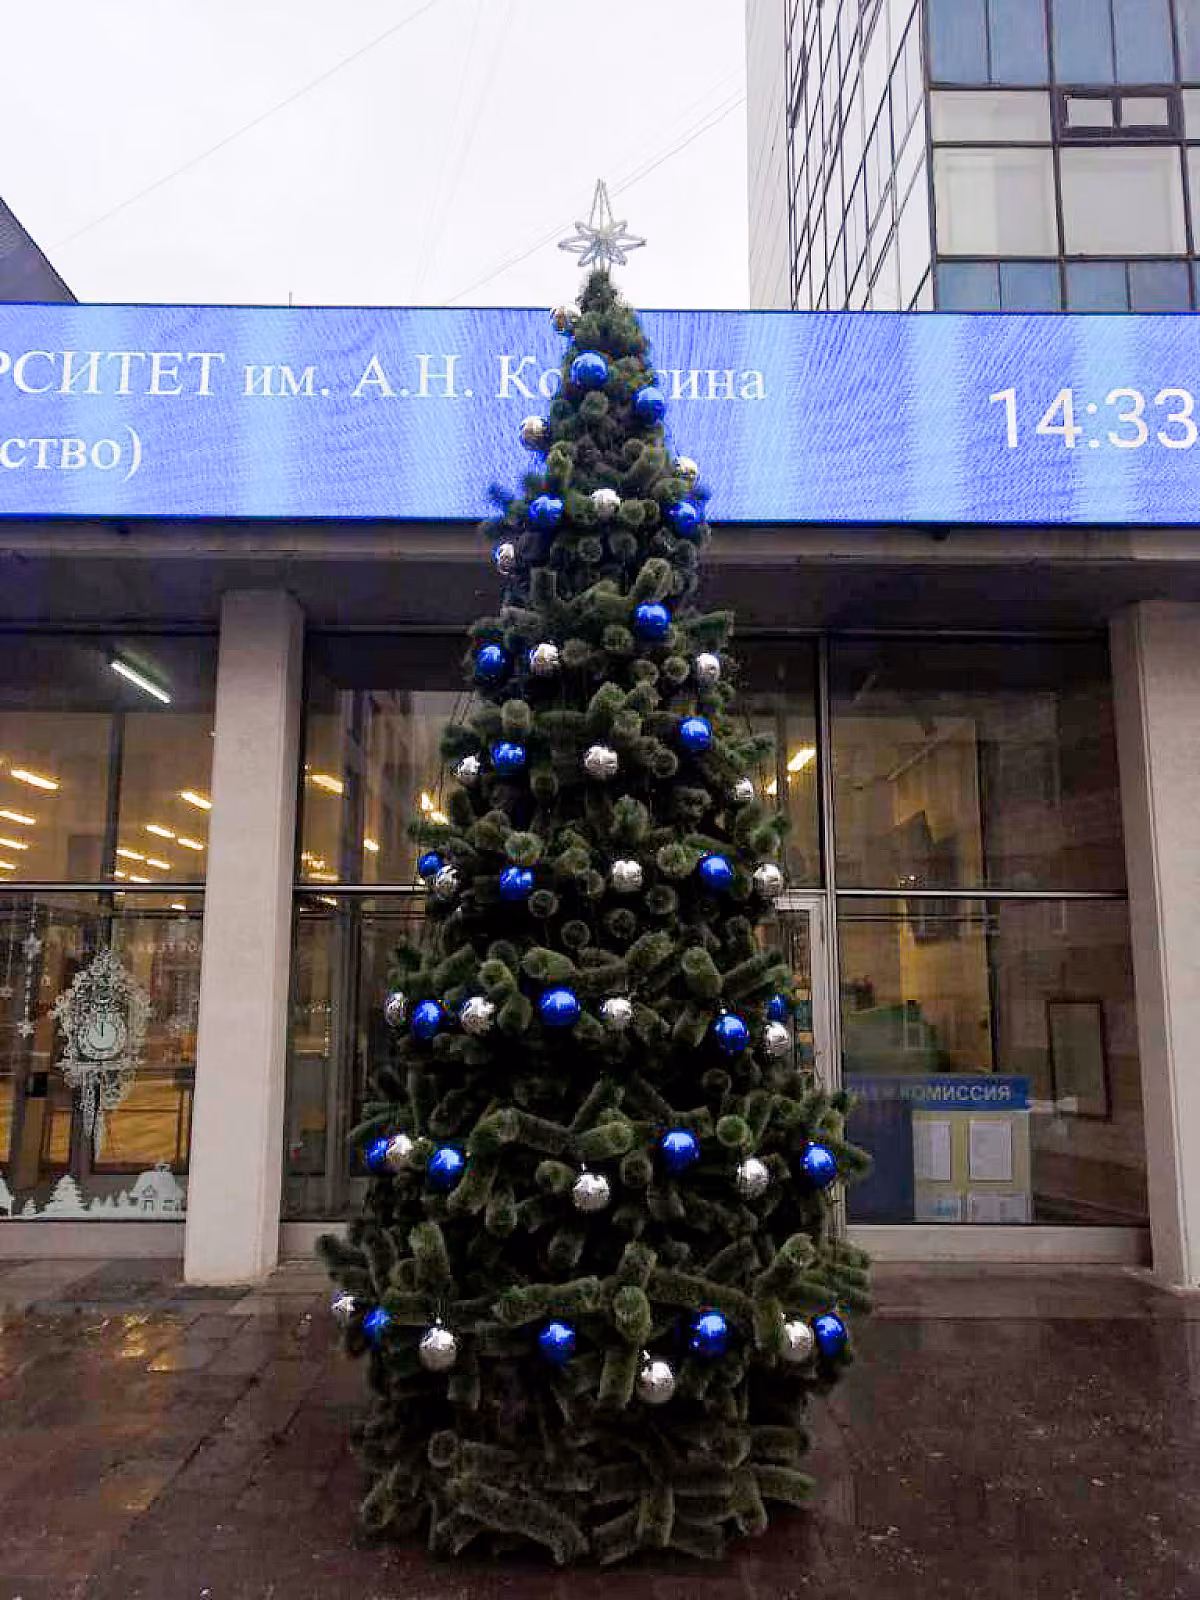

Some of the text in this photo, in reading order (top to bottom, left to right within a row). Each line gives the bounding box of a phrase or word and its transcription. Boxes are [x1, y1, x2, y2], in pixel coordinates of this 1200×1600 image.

[243, 364, 329, 397] им.
[351, 354, 473, 398] А.Н.
[498, 355, 767, 400] Коина
[990, 388, 1199, 448] 14:33
[0, 425, 142, 481] ство)
